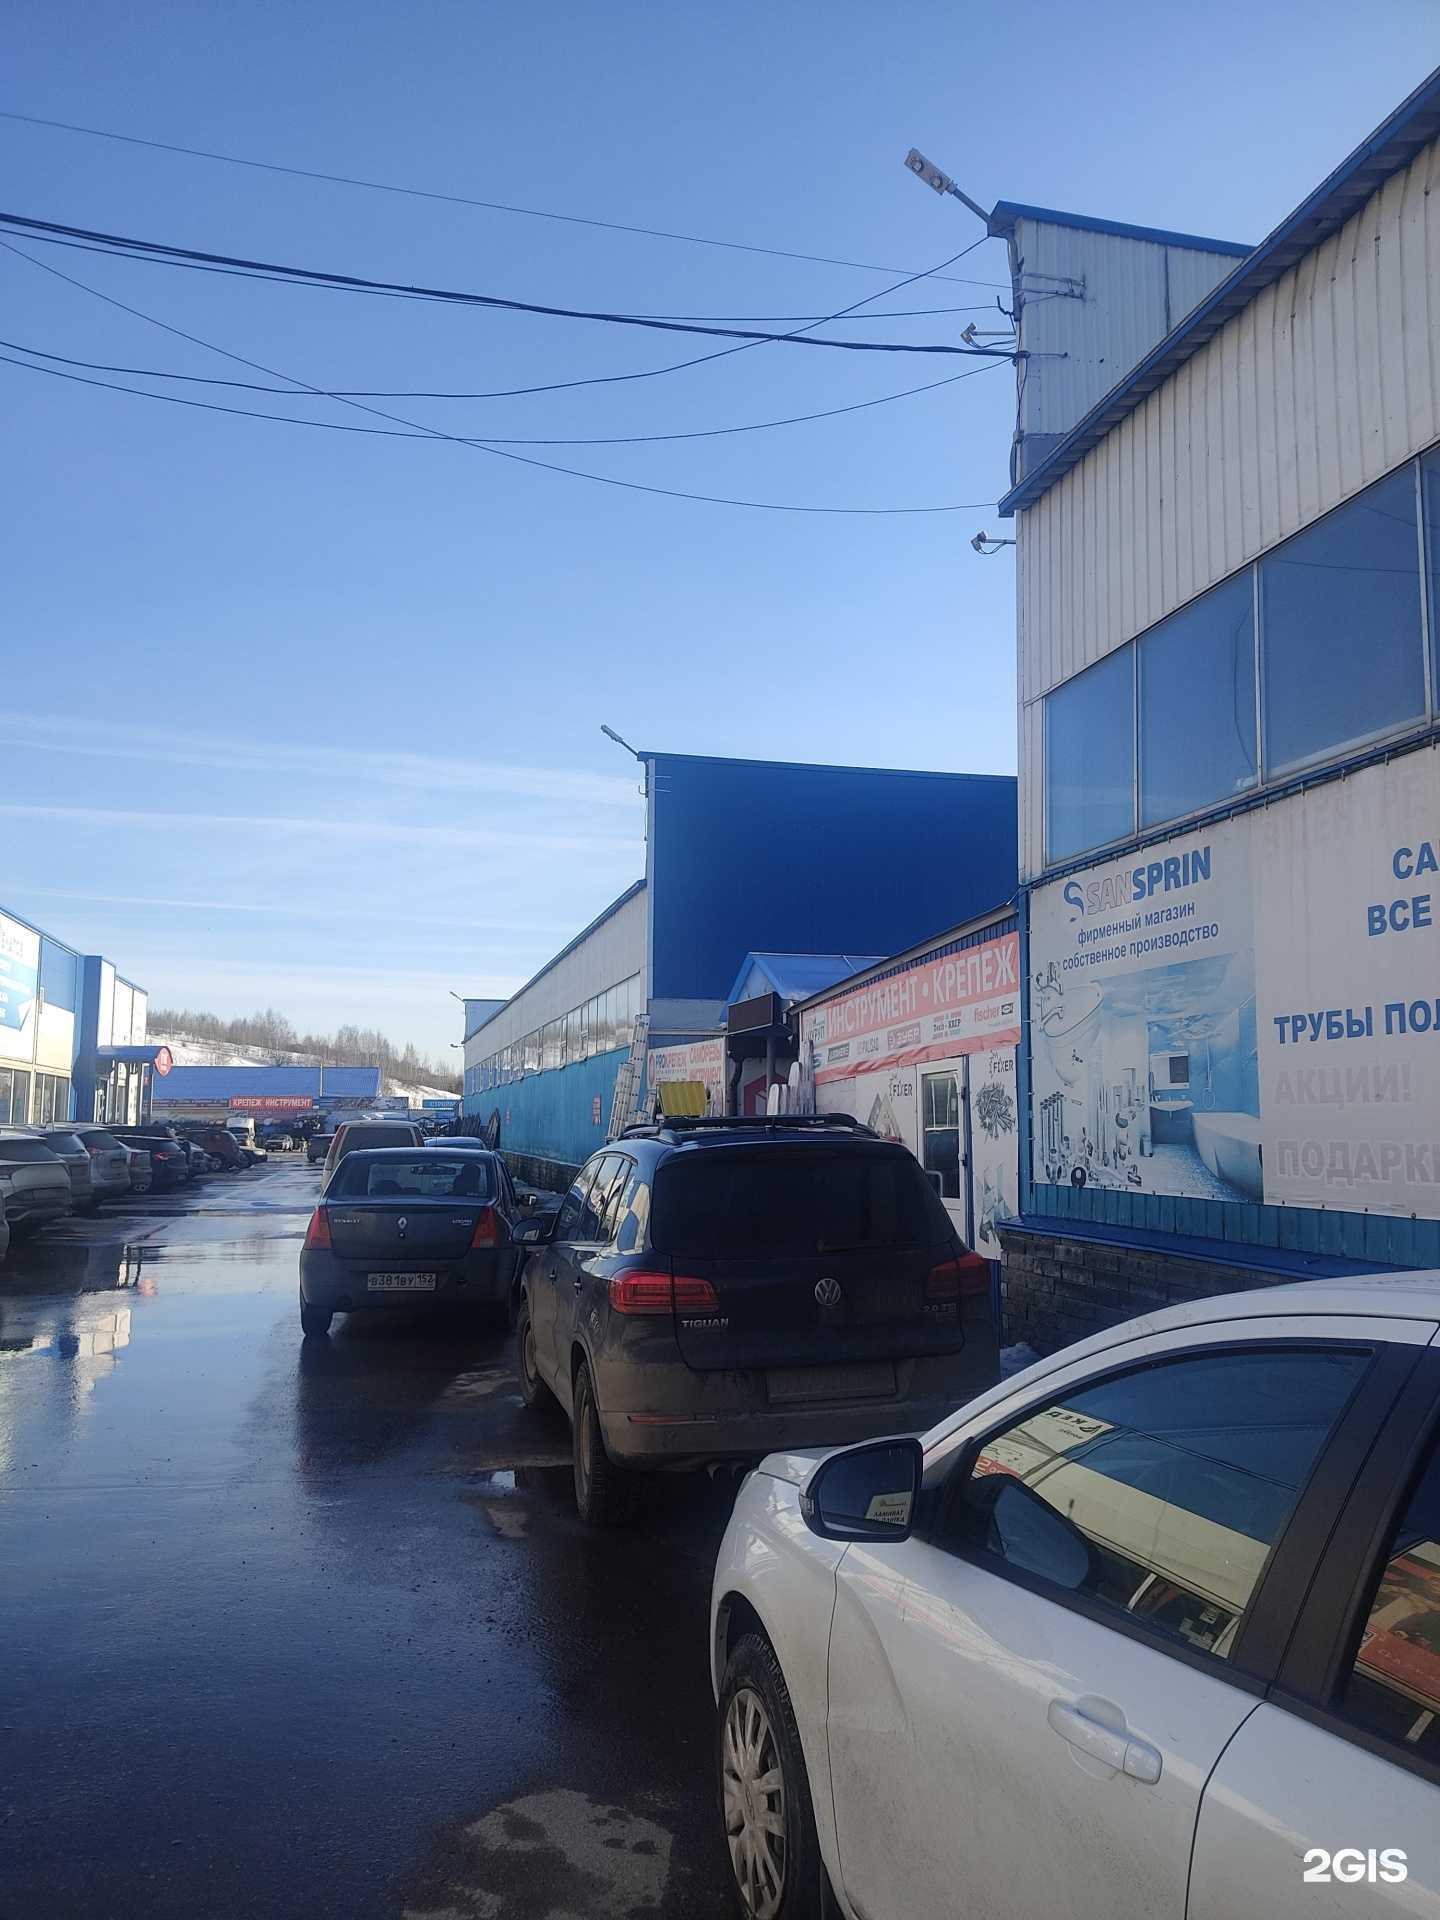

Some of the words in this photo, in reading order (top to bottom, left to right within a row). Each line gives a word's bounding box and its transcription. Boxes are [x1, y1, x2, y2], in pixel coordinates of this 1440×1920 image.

[1086, 846, 1211, 915] SANSPRIN
[1078, 914, 1142, 948] фирменный
[1145, 902, 1195, 926] магазин
[1368, 894, 1432, 936] ВСЕ
[1062, 944, 1126, 971] собственное
[1130, 923, 1219, 958] производство
[827, 974, 918, 1042] ИНСТРУМЕНТ
[932, 941, 1017, 1005] КРЕПЕЖ
[1274, 1006, 1373, 1044] ТРУБЫ
[993, 1058, 1014, 1073] FIXER
[1275, 1063, 1411, 1110] АКЦИИ!
[892, 1082, 913, 1097] FIXER
[680, 1317, 729, 1329] TIGUAN
